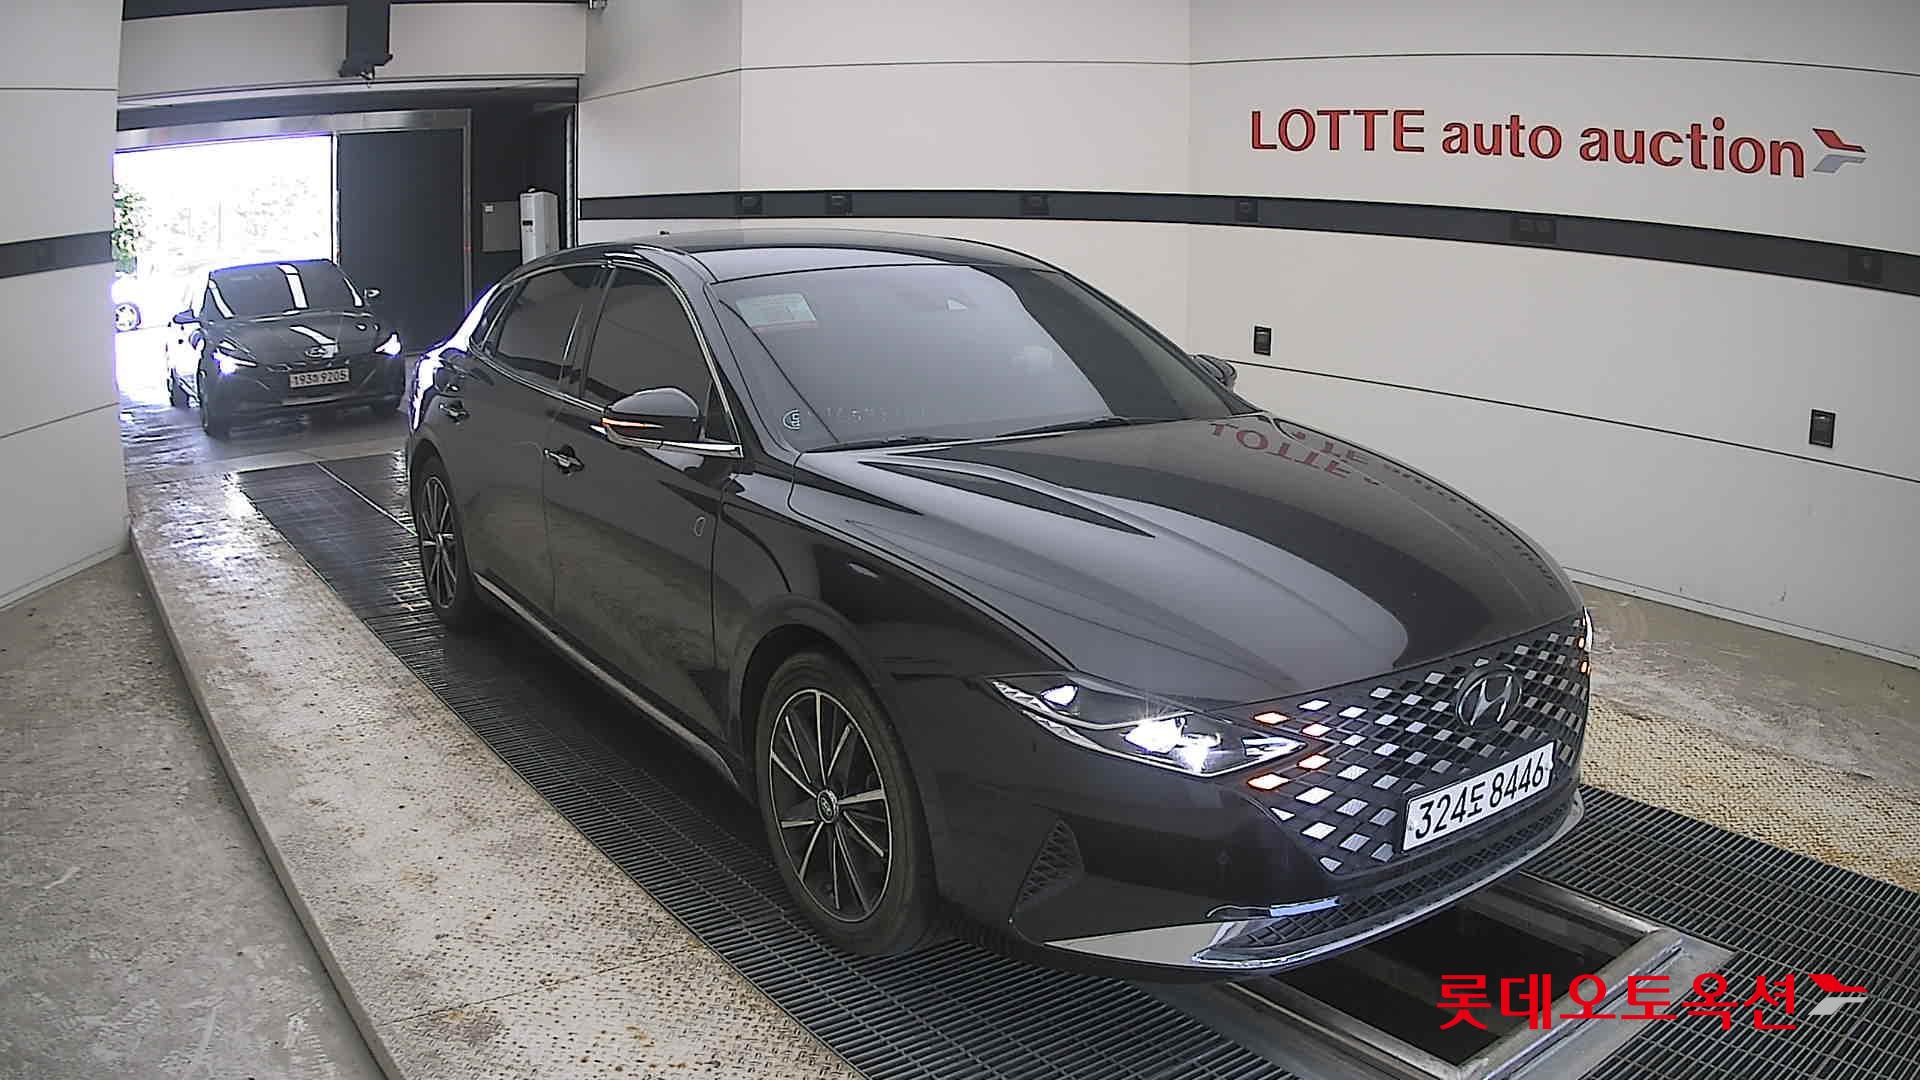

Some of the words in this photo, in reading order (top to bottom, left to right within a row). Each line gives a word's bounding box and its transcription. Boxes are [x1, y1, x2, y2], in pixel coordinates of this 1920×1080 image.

[1251, 109, 1425, 153] LOTTE
[1441, 114, 1562, 160] auto
[1579, 117, 1805, 178] auction
[1415, 781, 1486, 839] 324도
[1490, 752, 1544, 808] 8446
